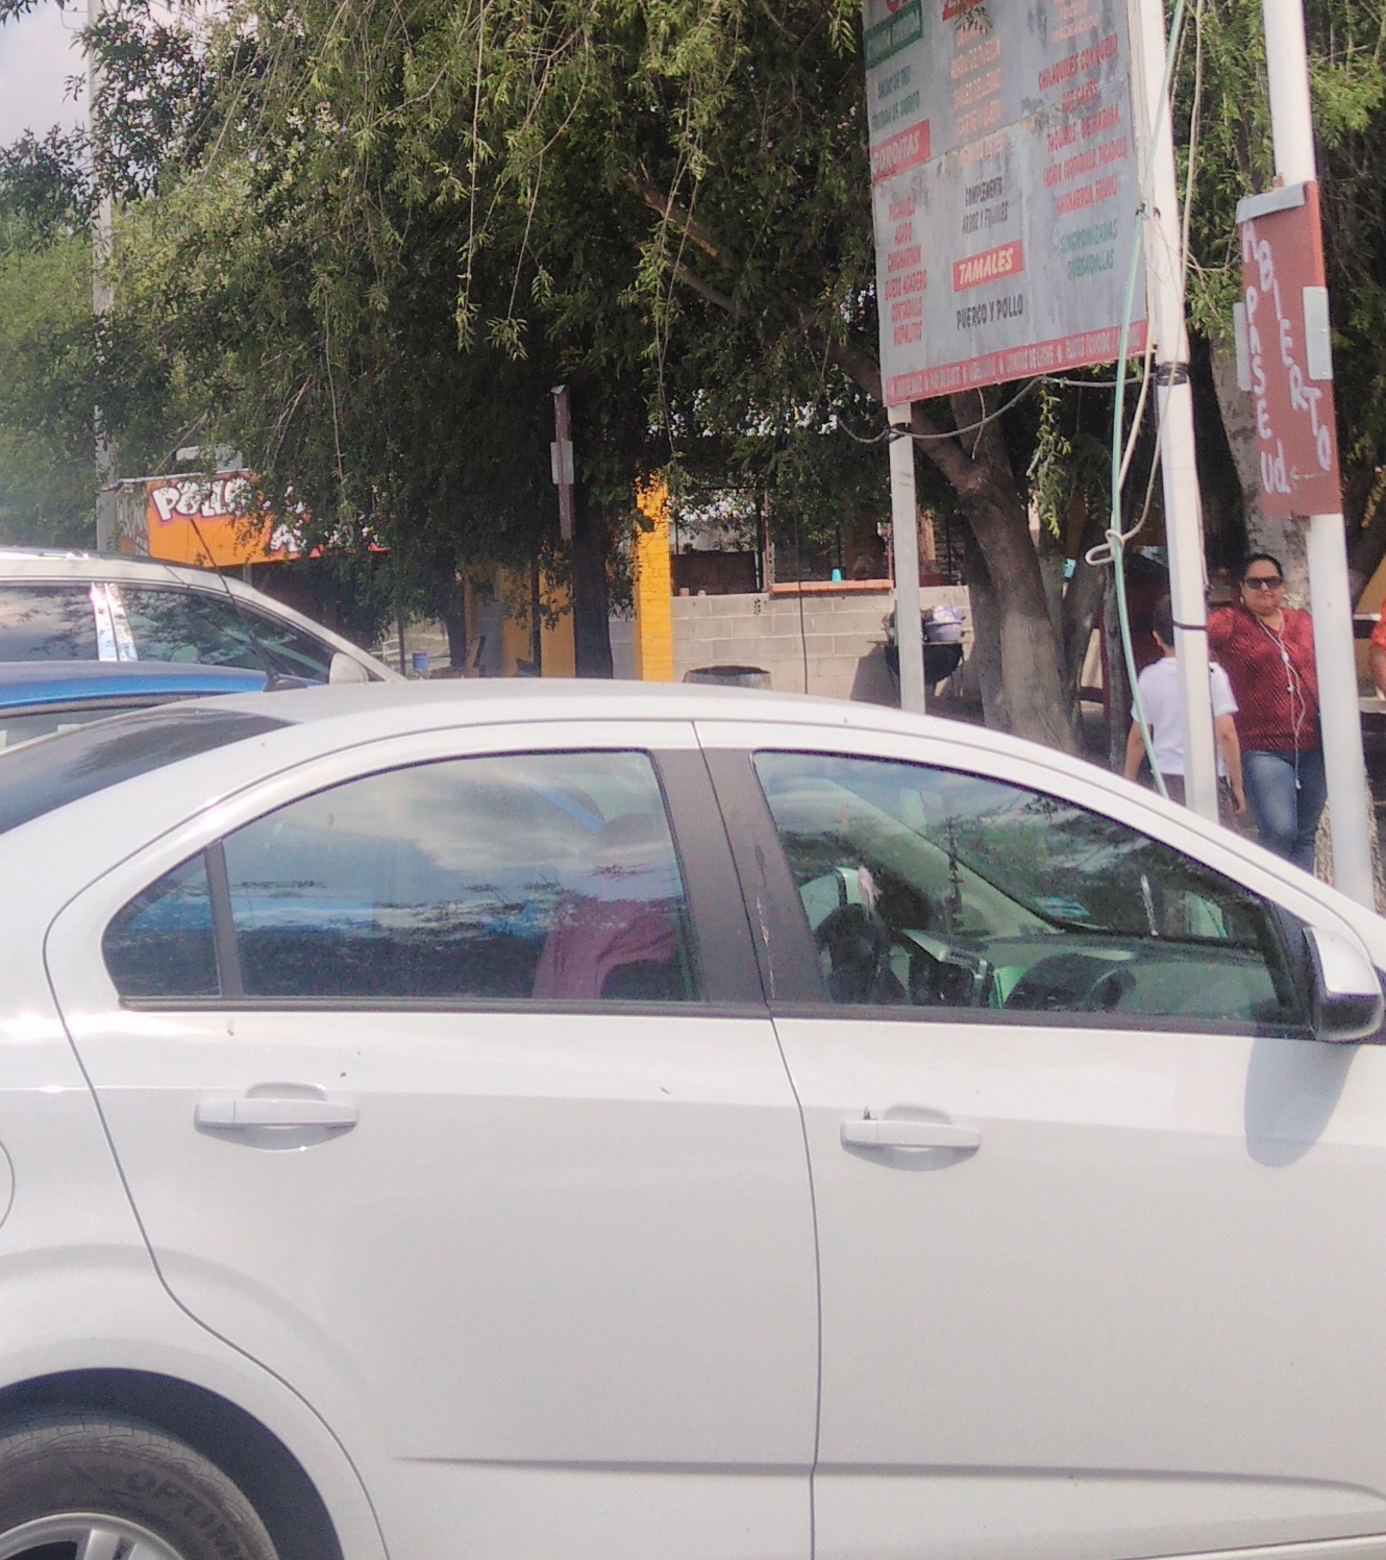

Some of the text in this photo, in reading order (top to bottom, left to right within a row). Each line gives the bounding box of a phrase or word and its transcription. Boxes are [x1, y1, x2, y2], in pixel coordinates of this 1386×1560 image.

[956, 294, 1023, 330] PUERCO Y POLLO
[959, 247, 1014, 285] TAMALES
[1243, 221, 1330, 471] ABIERTO
[1246, 287, 1271, 439] PASE
